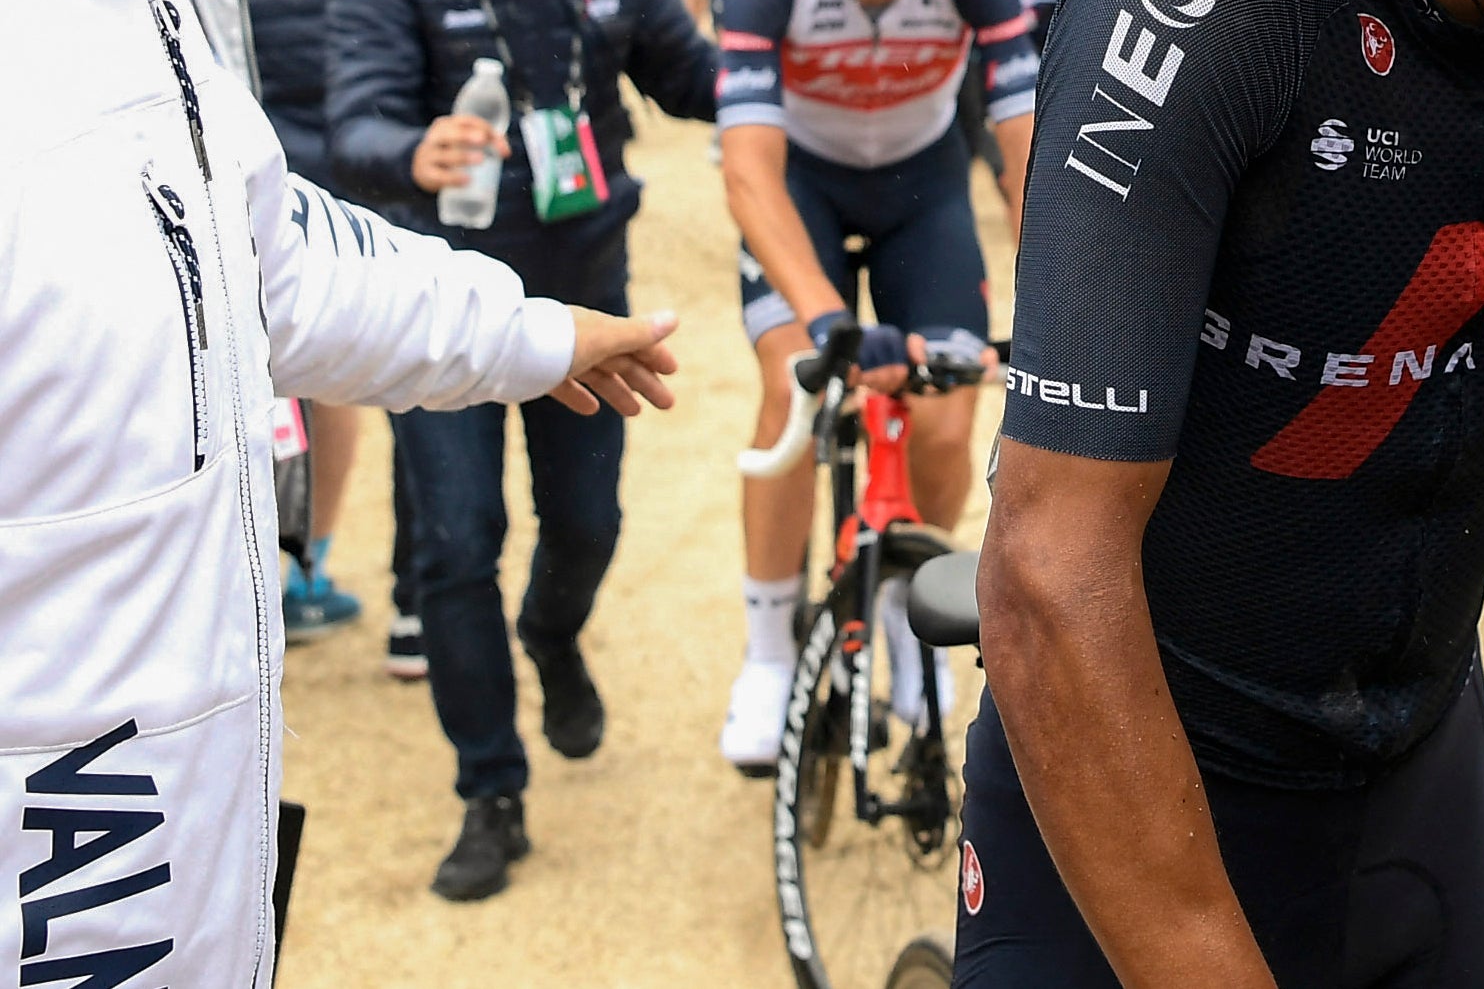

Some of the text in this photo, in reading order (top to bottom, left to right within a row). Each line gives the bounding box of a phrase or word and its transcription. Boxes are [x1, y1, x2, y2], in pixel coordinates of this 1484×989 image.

[1366, 128, 1399, 147] UCI
[1365, 146, 1423, 165] WORLD
[1362, 163, 1406, 181] TEAM
